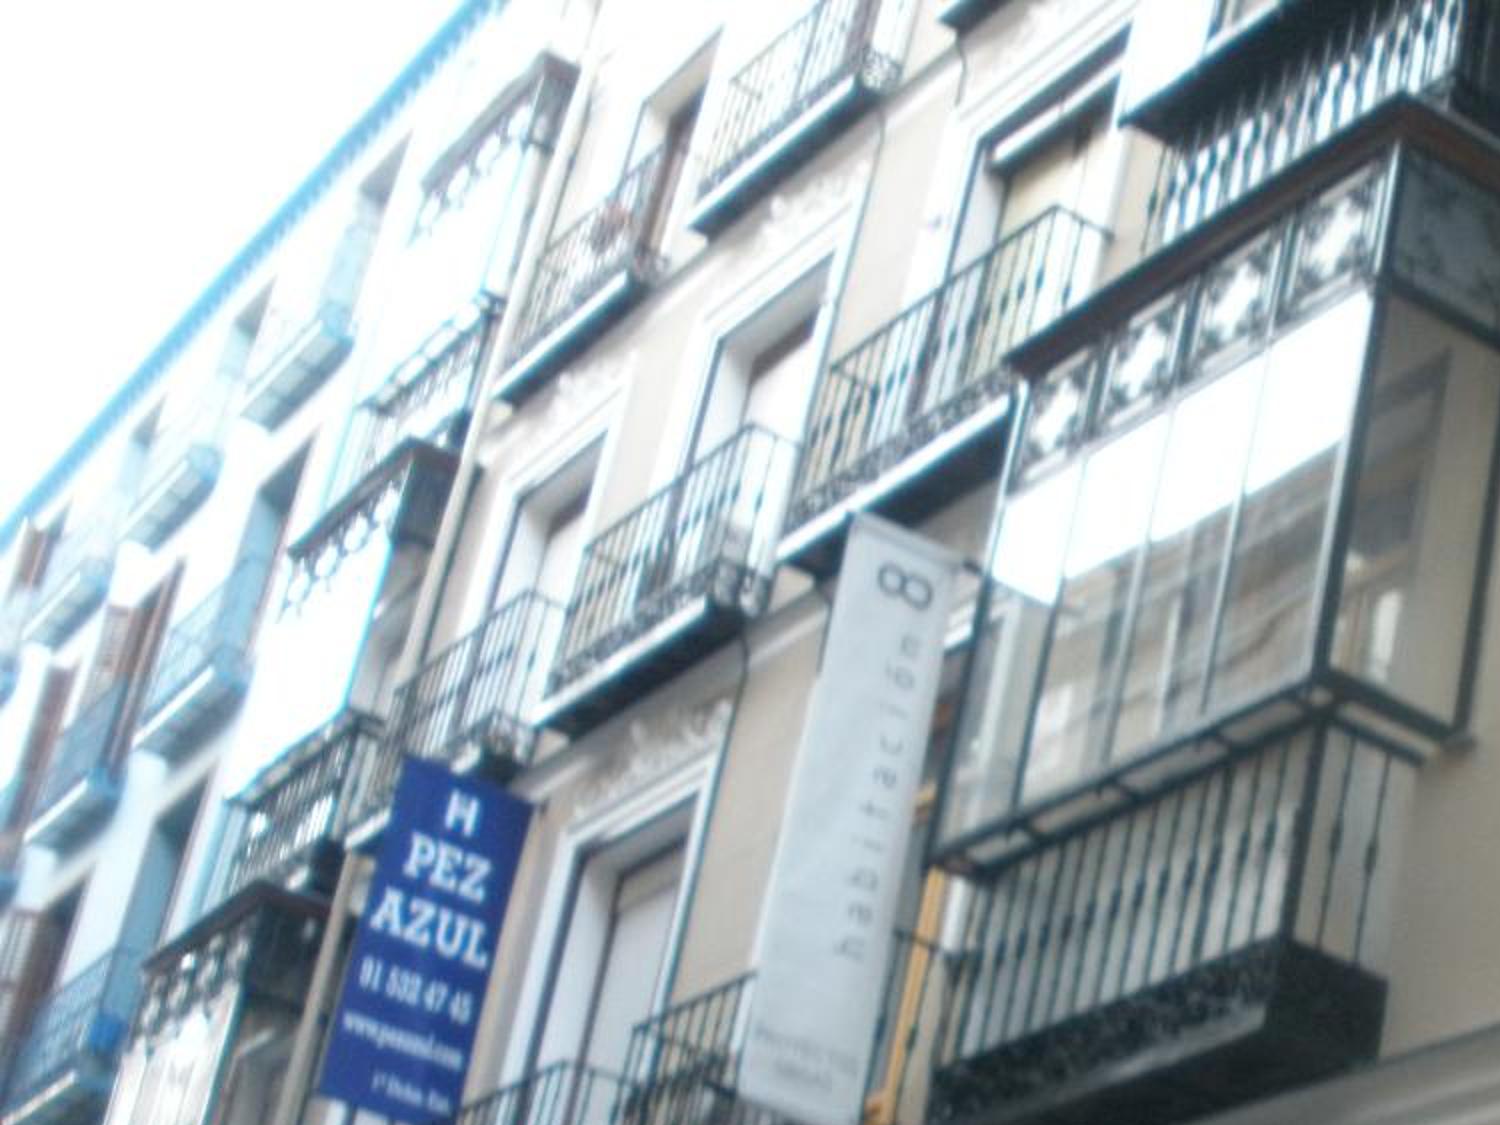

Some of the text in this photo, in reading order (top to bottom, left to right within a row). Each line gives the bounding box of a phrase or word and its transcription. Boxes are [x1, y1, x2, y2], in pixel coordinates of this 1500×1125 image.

[835, 562, 931, 961] habitación 8
[404, 832, 493, 903] PEZ
[370, 887, 488, 969] AZUL
